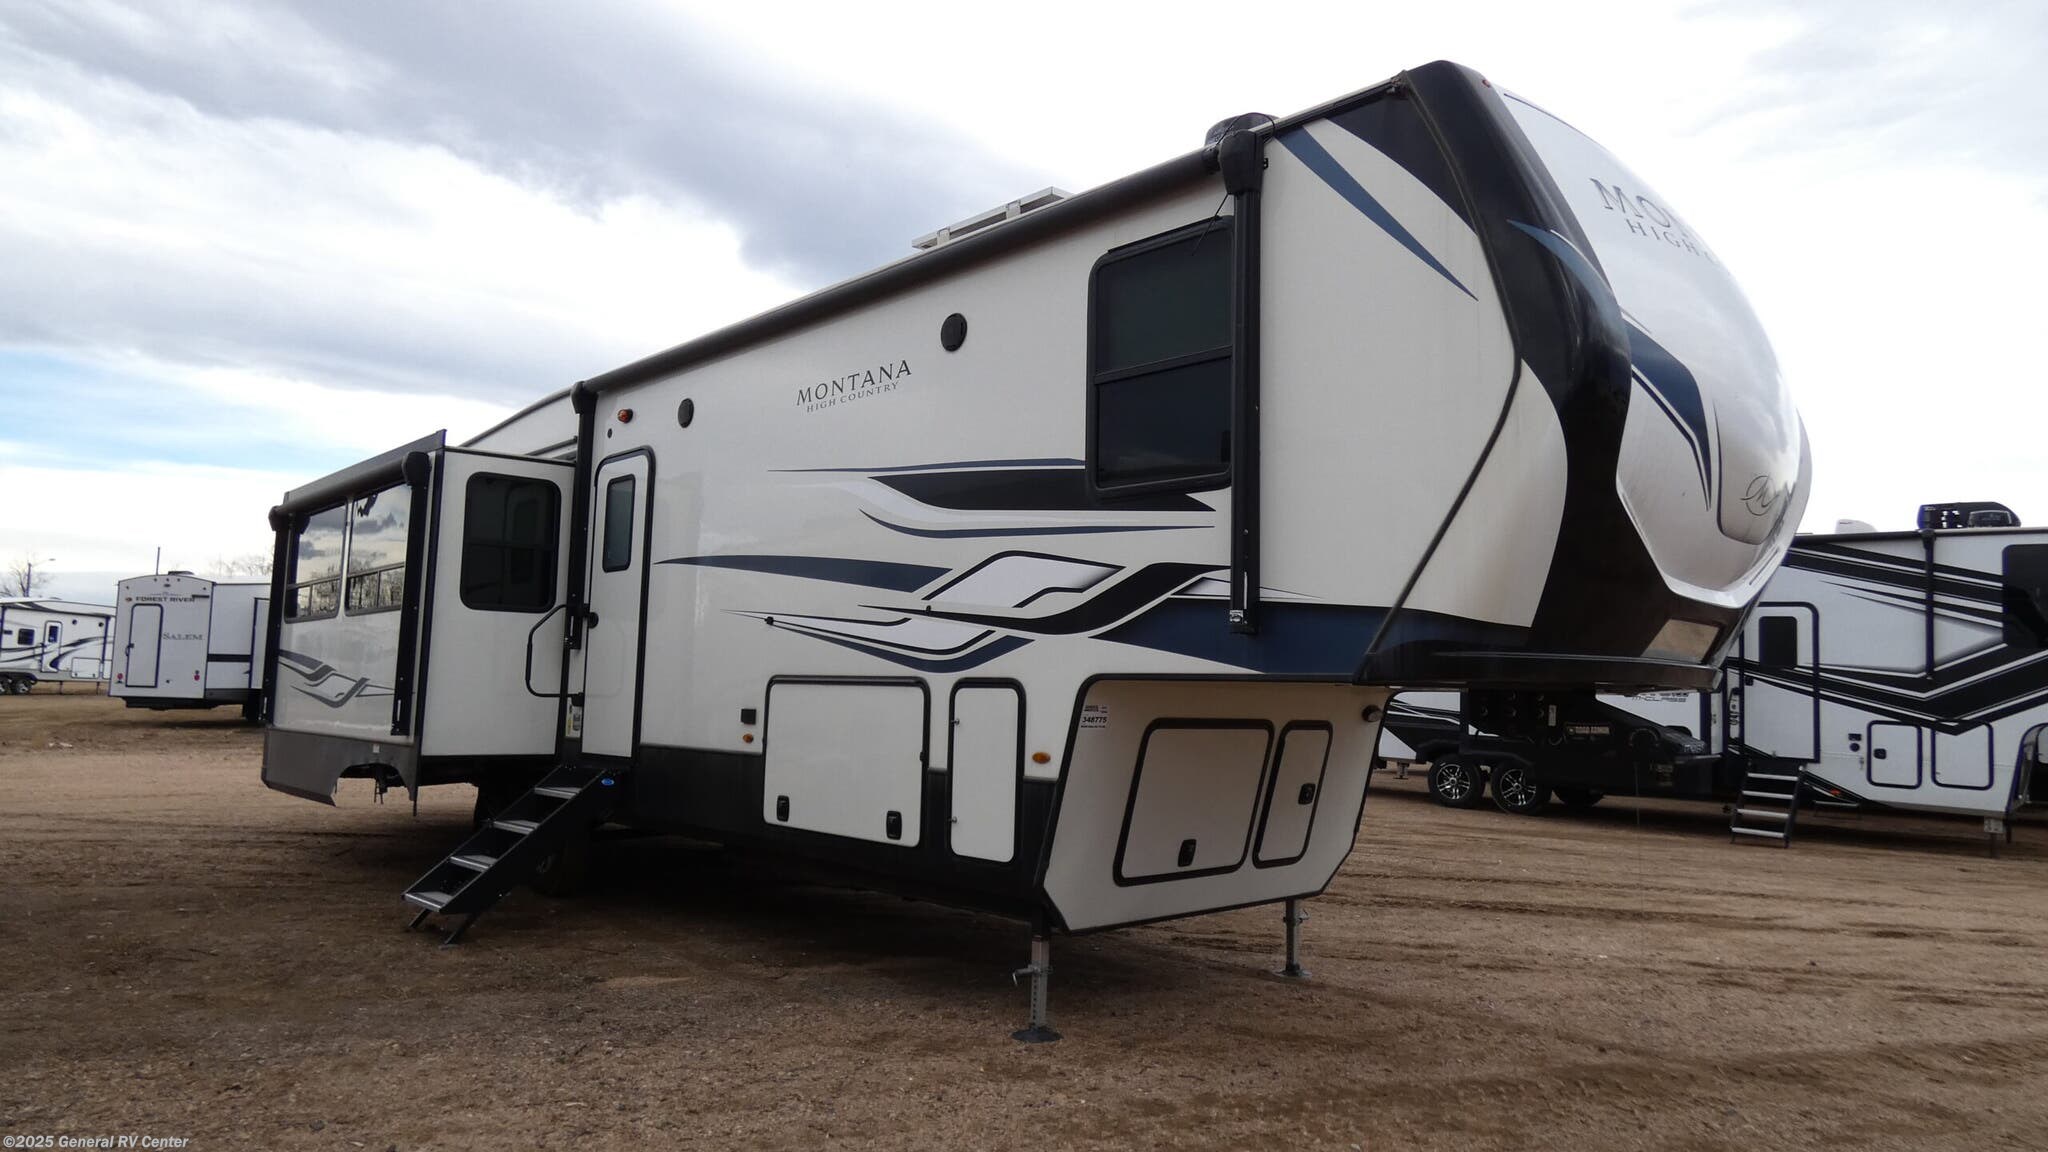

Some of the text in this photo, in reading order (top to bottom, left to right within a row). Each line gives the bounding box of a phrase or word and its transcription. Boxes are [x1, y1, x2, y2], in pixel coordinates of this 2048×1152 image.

[1626, 218, 1700, 256] HIGH
[796, 359, 912, 406] MONTANA
[806, 381, 899, 413] HIGH COUNTRY
[163, 632, 203, 641] SALEM
[1082, 716, 1107, 724] 348775
